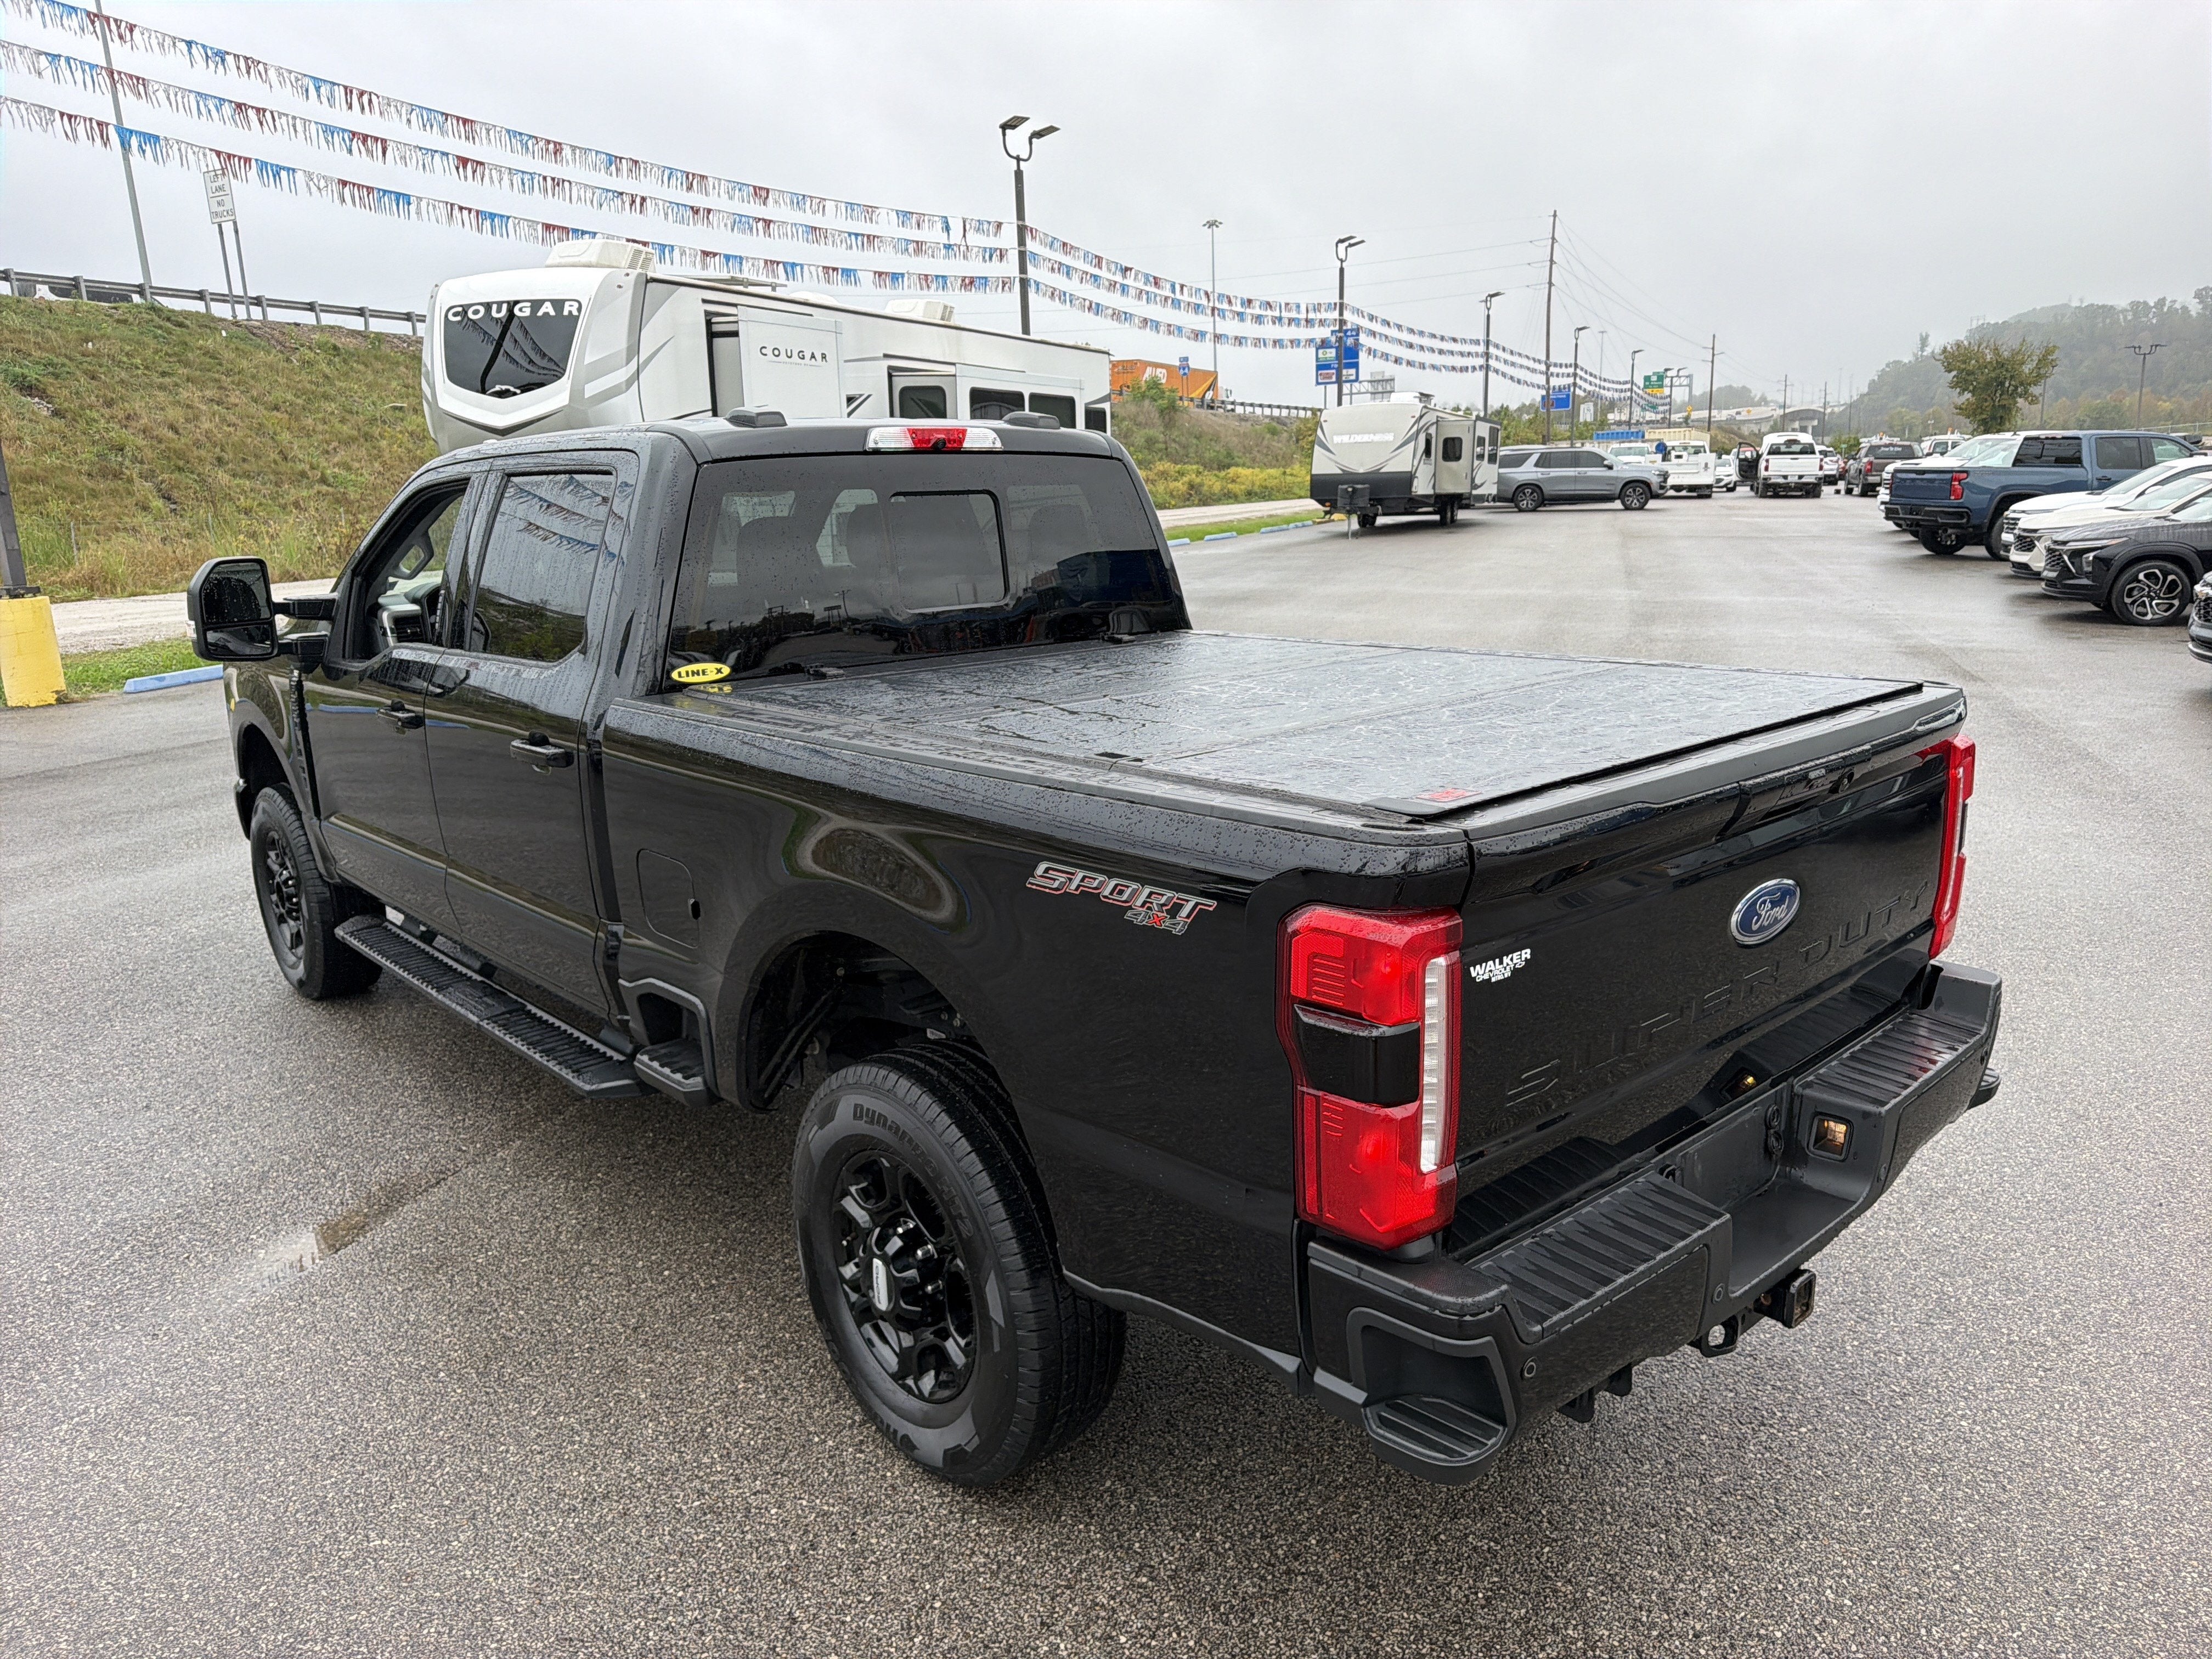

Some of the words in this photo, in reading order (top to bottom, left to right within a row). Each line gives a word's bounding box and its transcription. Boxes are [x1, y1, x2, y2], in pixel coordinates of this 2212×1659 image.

[210, 173, 223, 183] LEFT
[211, 184, 226, 194] LANE
[216, 199, 225, 207] NO
[211, 208, 234, 219] TRUCKS
[448, 301, 579, 321] COUGAR
[759, 346, 828, 363] COUGAR
[1026, 861, 1217, 921] SPORT
[1752, 892, 1790, 931] Ford
[1799, 880, 1929, 964] DUTY
[1470, 948, 1531, 978] WALKER
[1476, 964, 1514, 982] CHEVROLET
